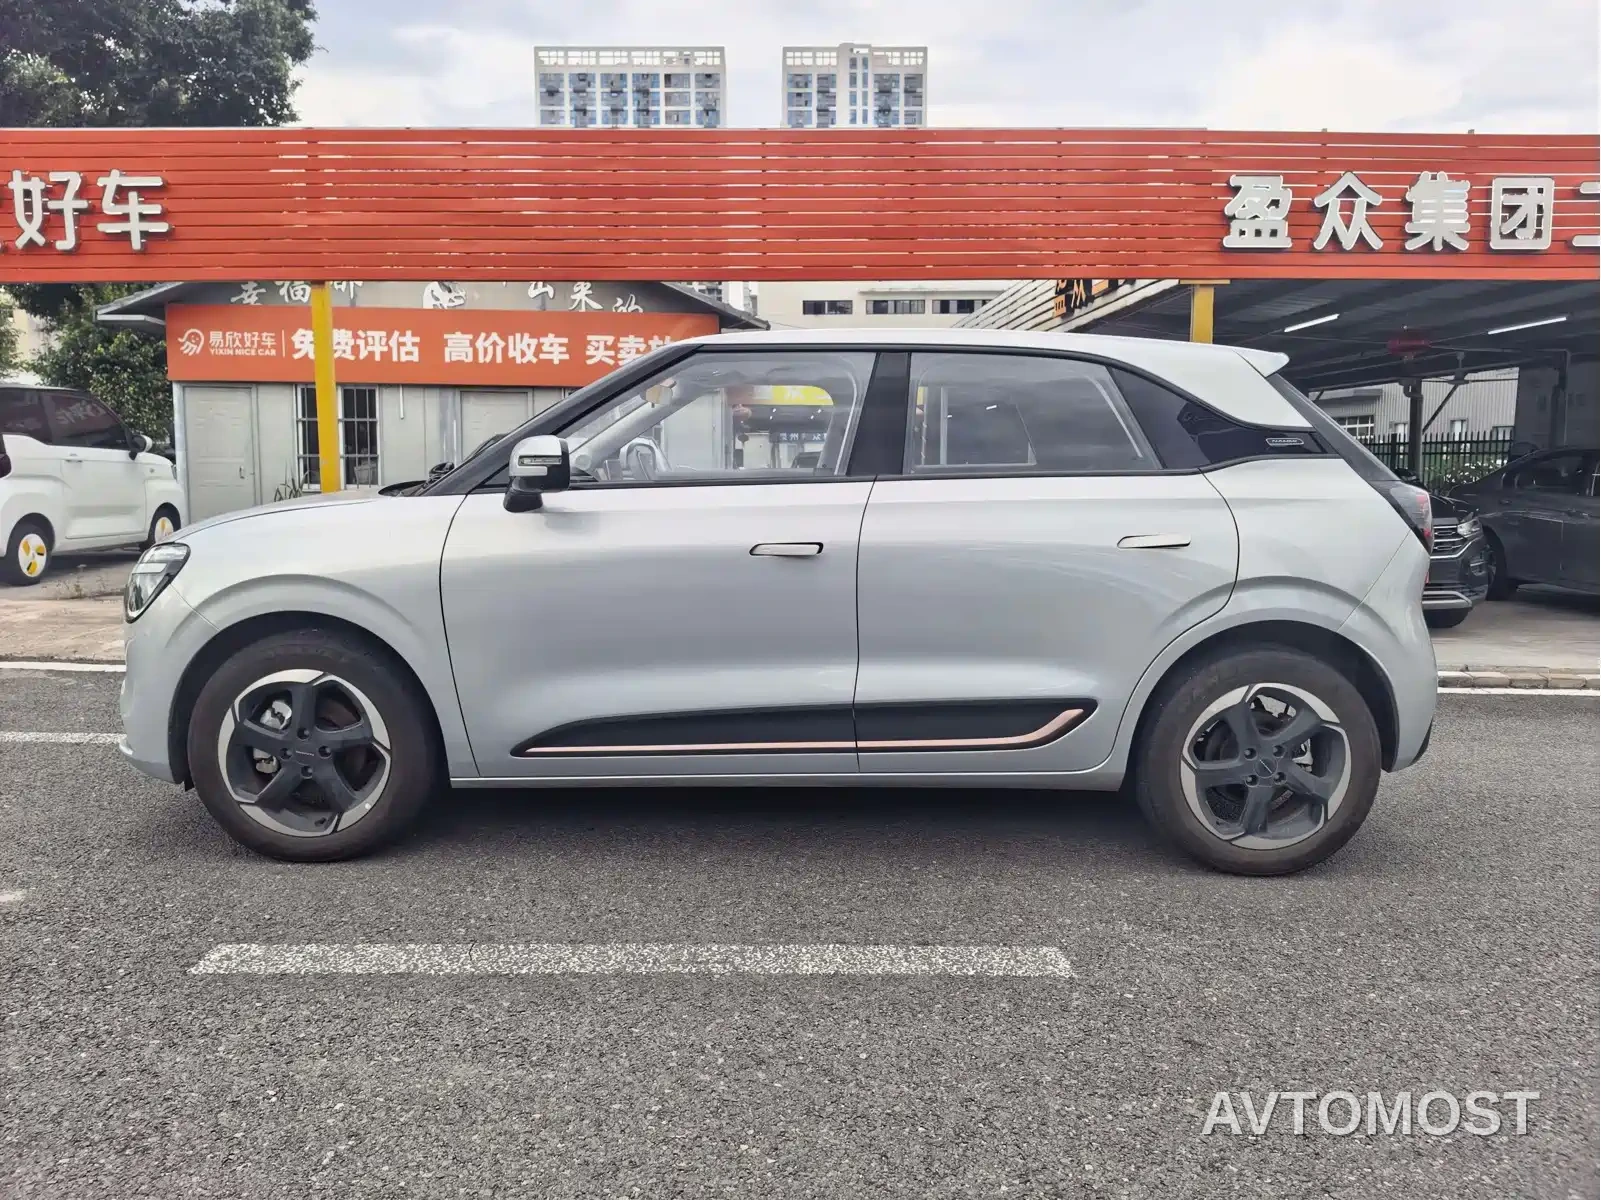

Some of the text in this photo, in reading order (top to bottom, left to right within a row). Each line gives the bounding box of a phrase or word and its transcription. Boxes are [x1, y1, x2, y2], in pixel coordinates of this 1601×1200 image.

[0, 168, 170, 250] 好车
[209, 331, 276, 349] 易欣好车
[209, 348, 277, 356] YIXIN NICE CAR
[291, 328, 420, 362] 免费评估
[443, 331, 570, 365] 高价收车
